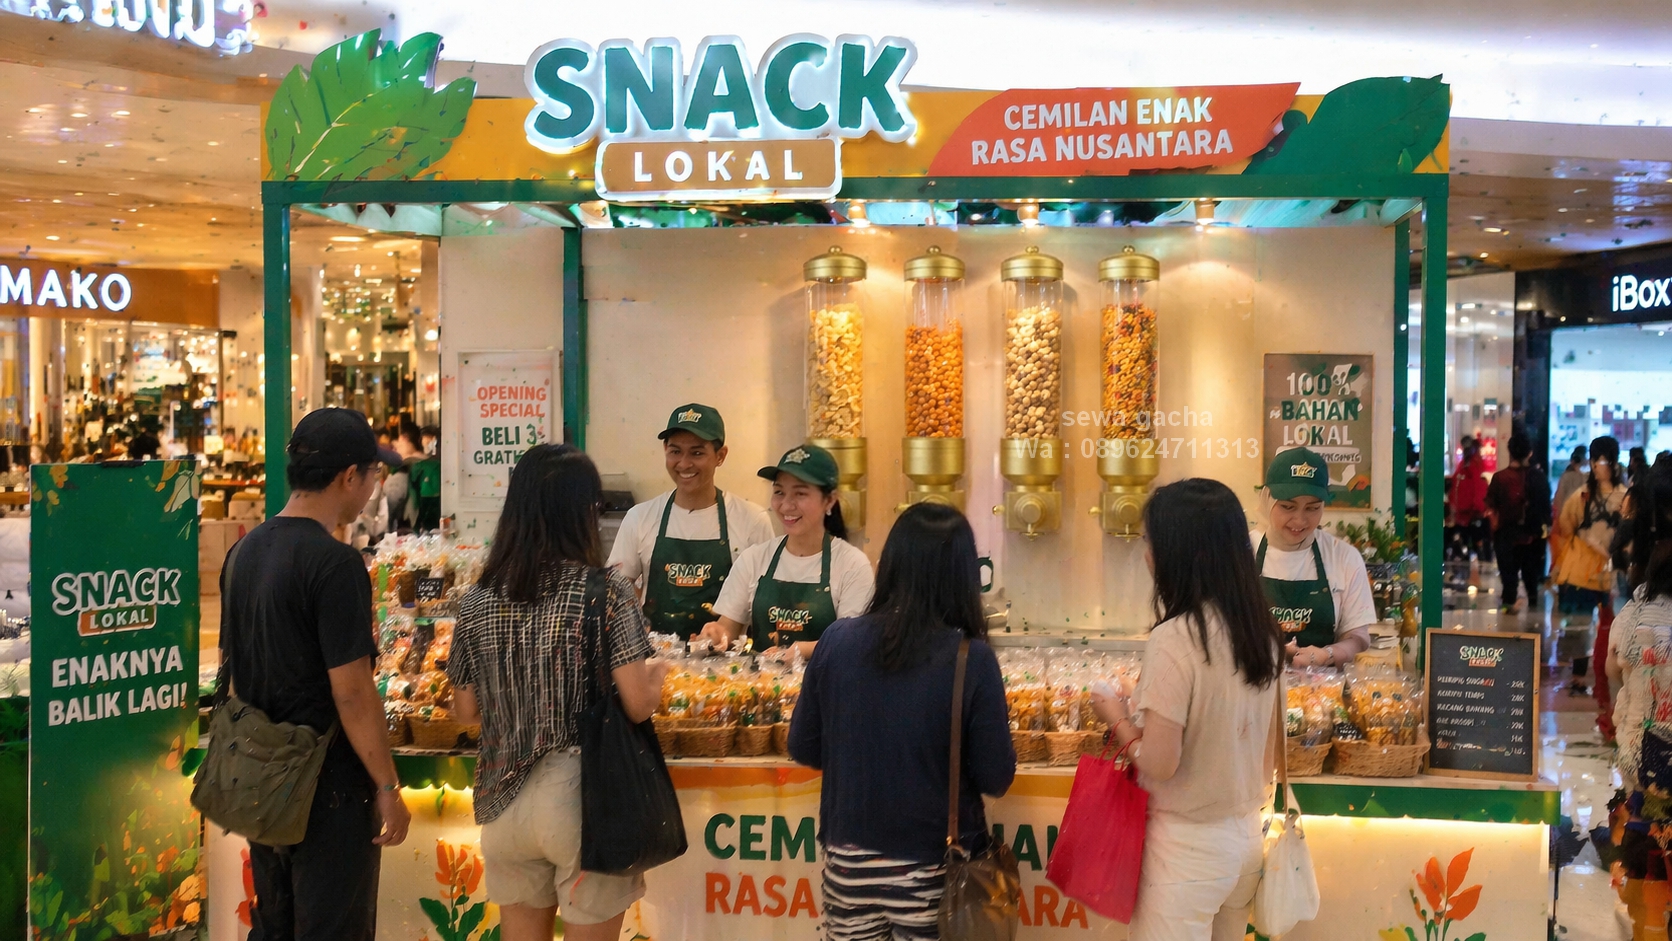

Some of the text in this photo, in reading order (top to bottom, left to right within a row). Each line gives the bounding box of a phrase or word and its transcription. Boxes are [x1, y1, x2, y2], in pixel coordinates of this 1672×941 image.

[533, 41, 908, 139] SNACK
[1003, 96, 1213, 131] CEMILAN ENAK
[971, 129, 1234, 165] RASA NUSANTARA
[633, 149, 803, 183] LOKAL
[0, 265, 132, 311] MAKO
[477, 386, 547, 401] OPENING
[480, 403, 546, 418] SPECIAL
[1281, 399, 1360, 421] BAHAN
[482, 426, 520, 445] BELI
[1283, 424, 1353, 446] LOKAL
[668, 563, 711, 579] SNACK
[52, 568, 182, 616] SNACK
[89, 608, 149, 630] LOKAL
[52, 645, 183, 688] ENAKNYA
[48, 682, 188, 727] BALIK LAGI!
[704, 813, 817, 863] CEM
[705, 872, 819, 919] RASA
